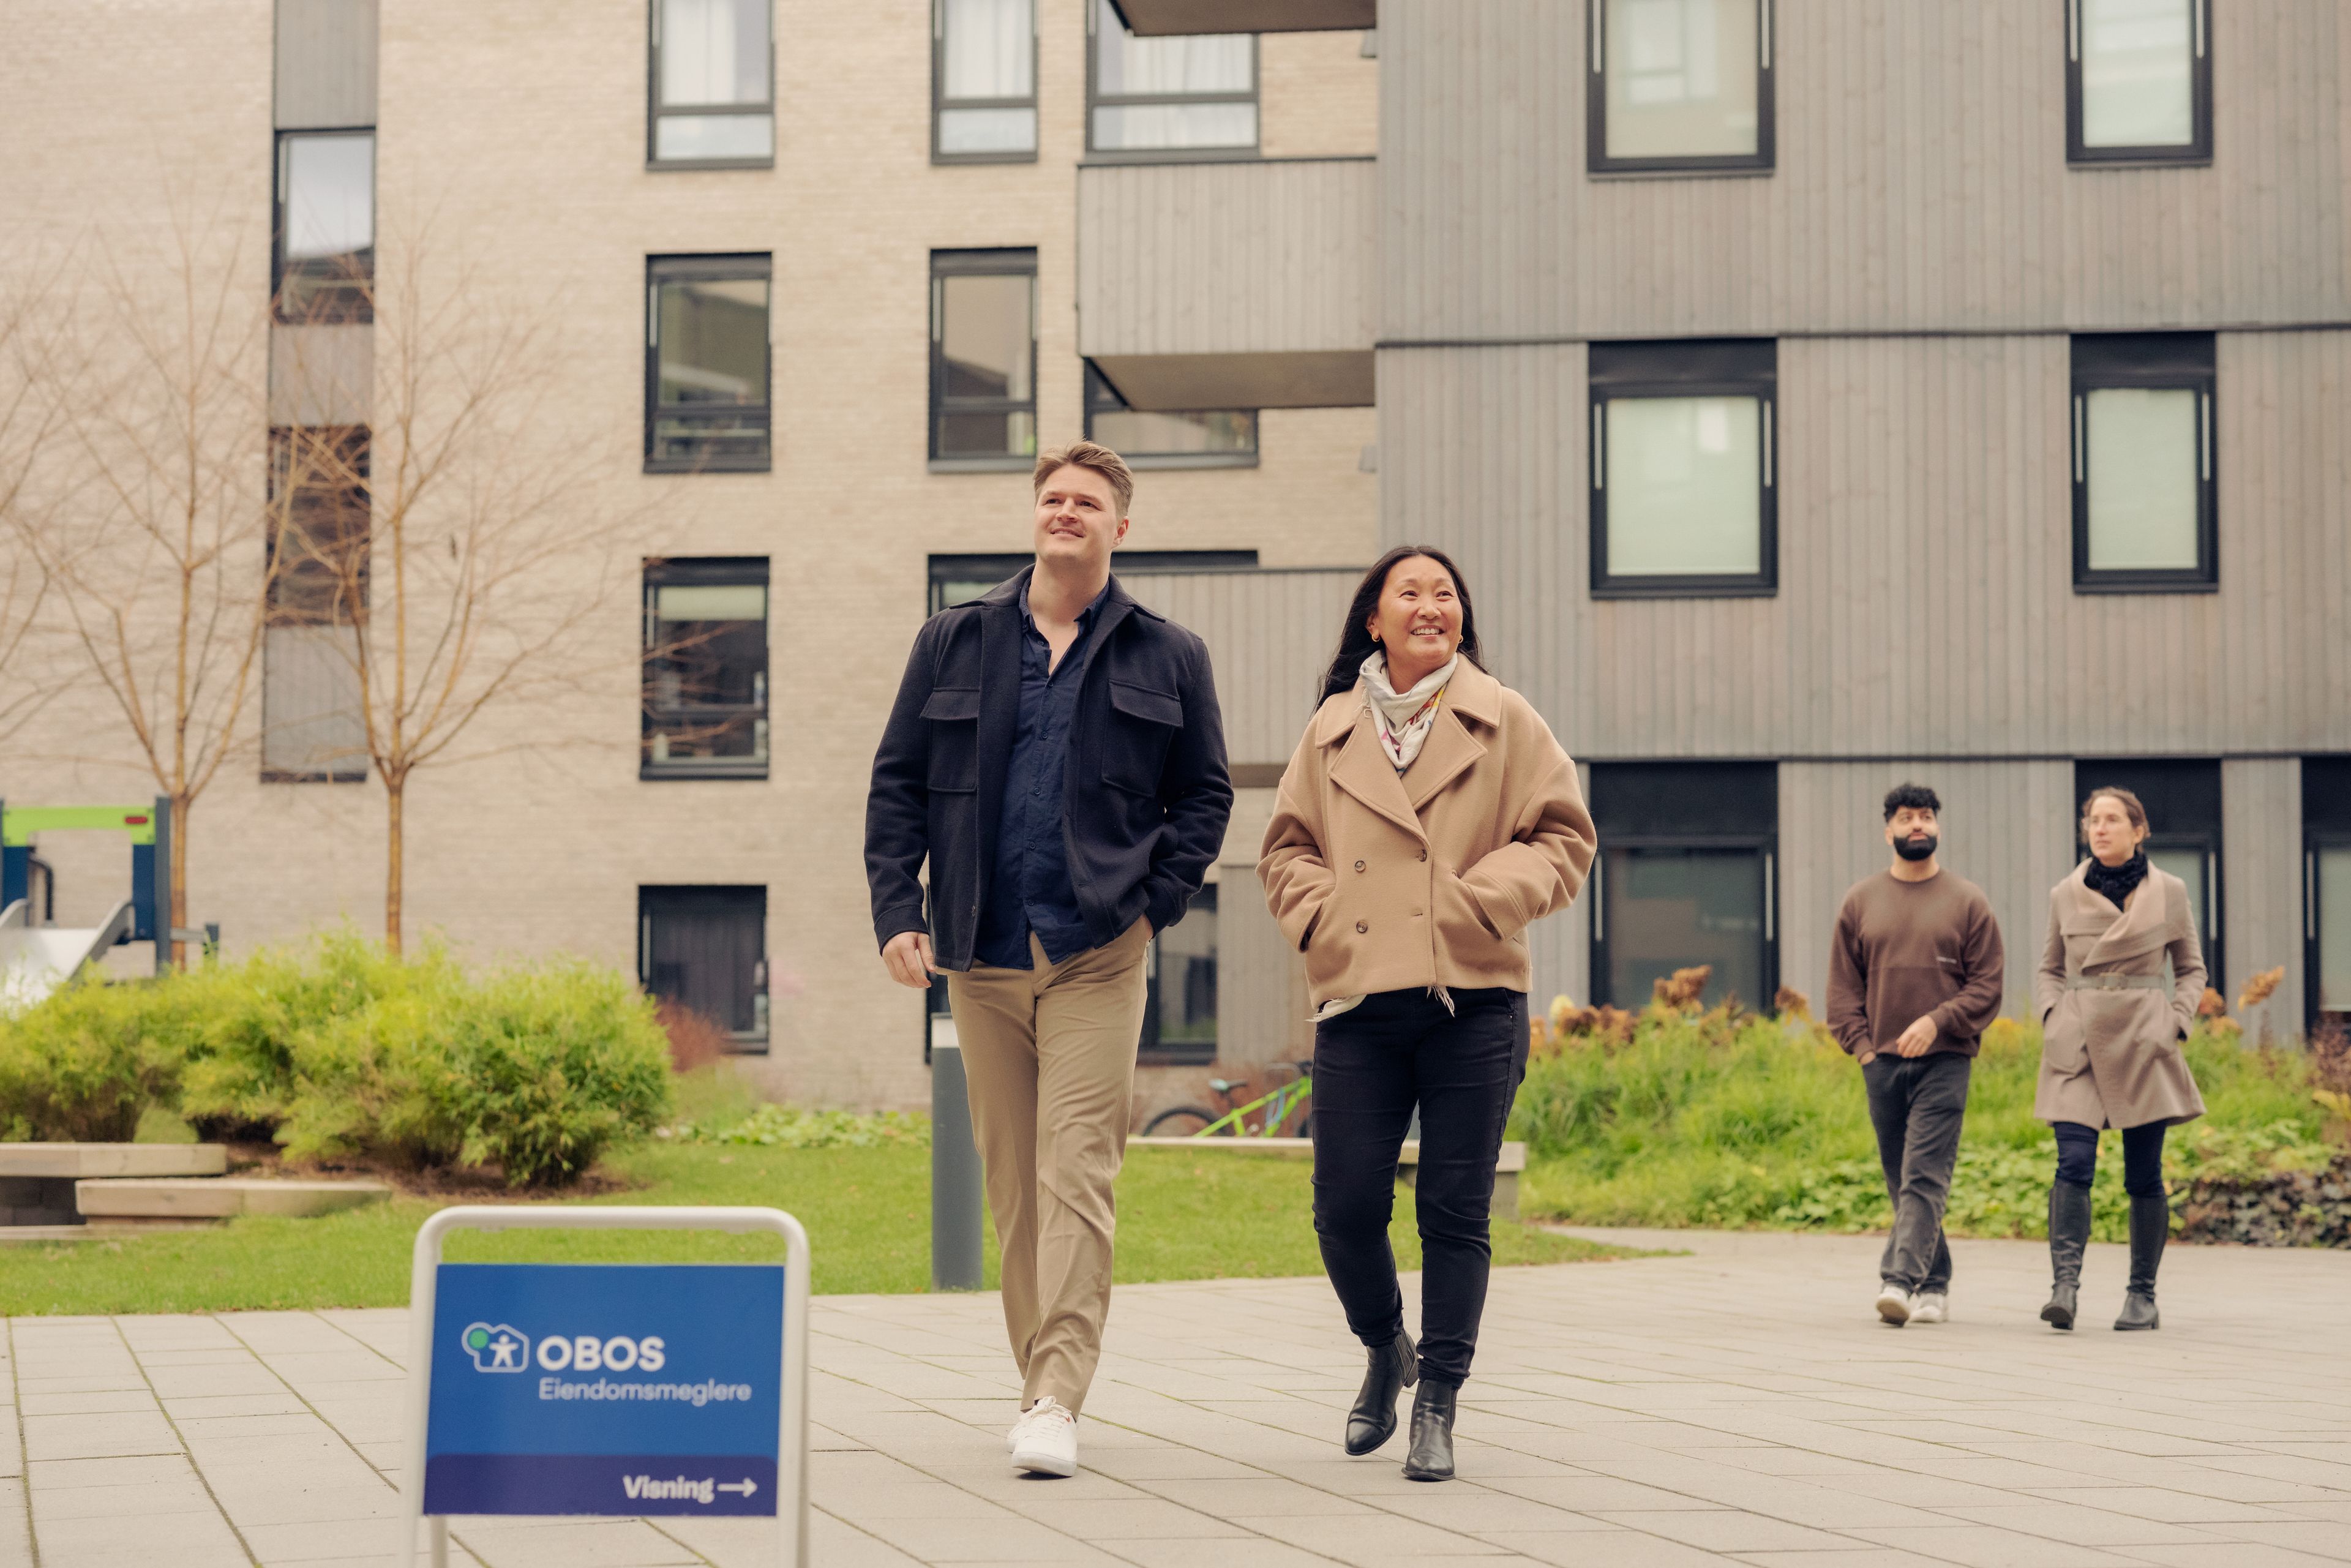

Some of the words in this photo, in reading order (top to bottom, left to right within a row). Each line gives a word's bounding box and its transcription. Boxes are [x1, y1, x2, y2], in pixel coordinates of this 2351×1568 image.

[536, 1336, 665, 1371] OBOS
[539, 1377, 751, 1406] Eiendomsmeglere
[623, 1475, 714, 1503] Visning
